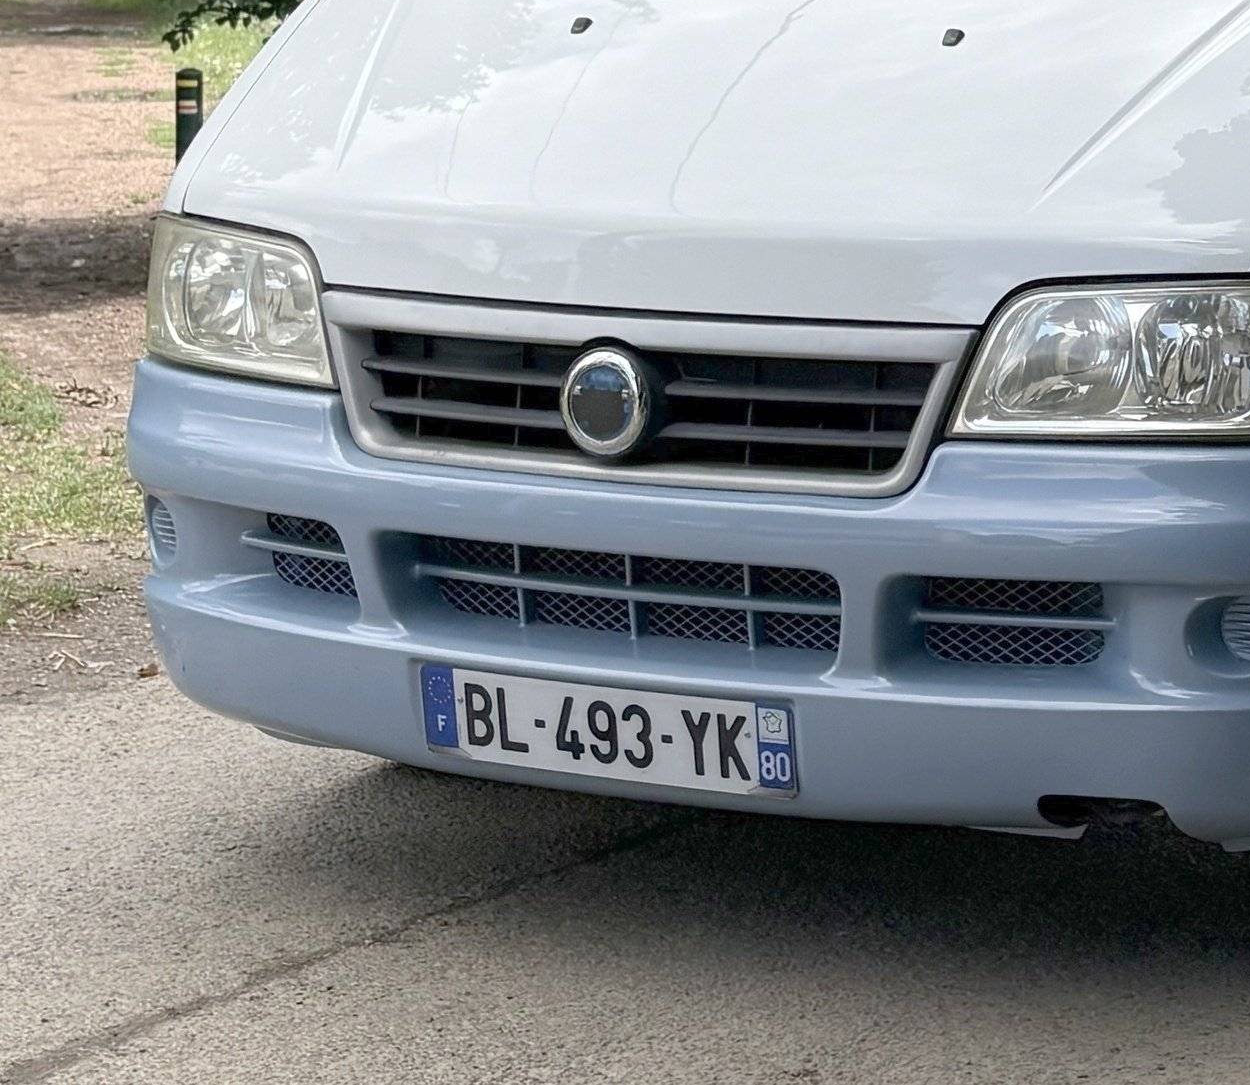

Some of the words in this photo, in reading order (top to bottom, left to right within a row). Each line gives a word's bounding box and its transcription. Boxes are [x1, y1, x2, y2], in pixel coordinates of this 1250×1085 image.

[436, 714, 447, 732] F
[463, 682, 751, 782] BL-493-YK
[760, 750, 791, 782] 80
